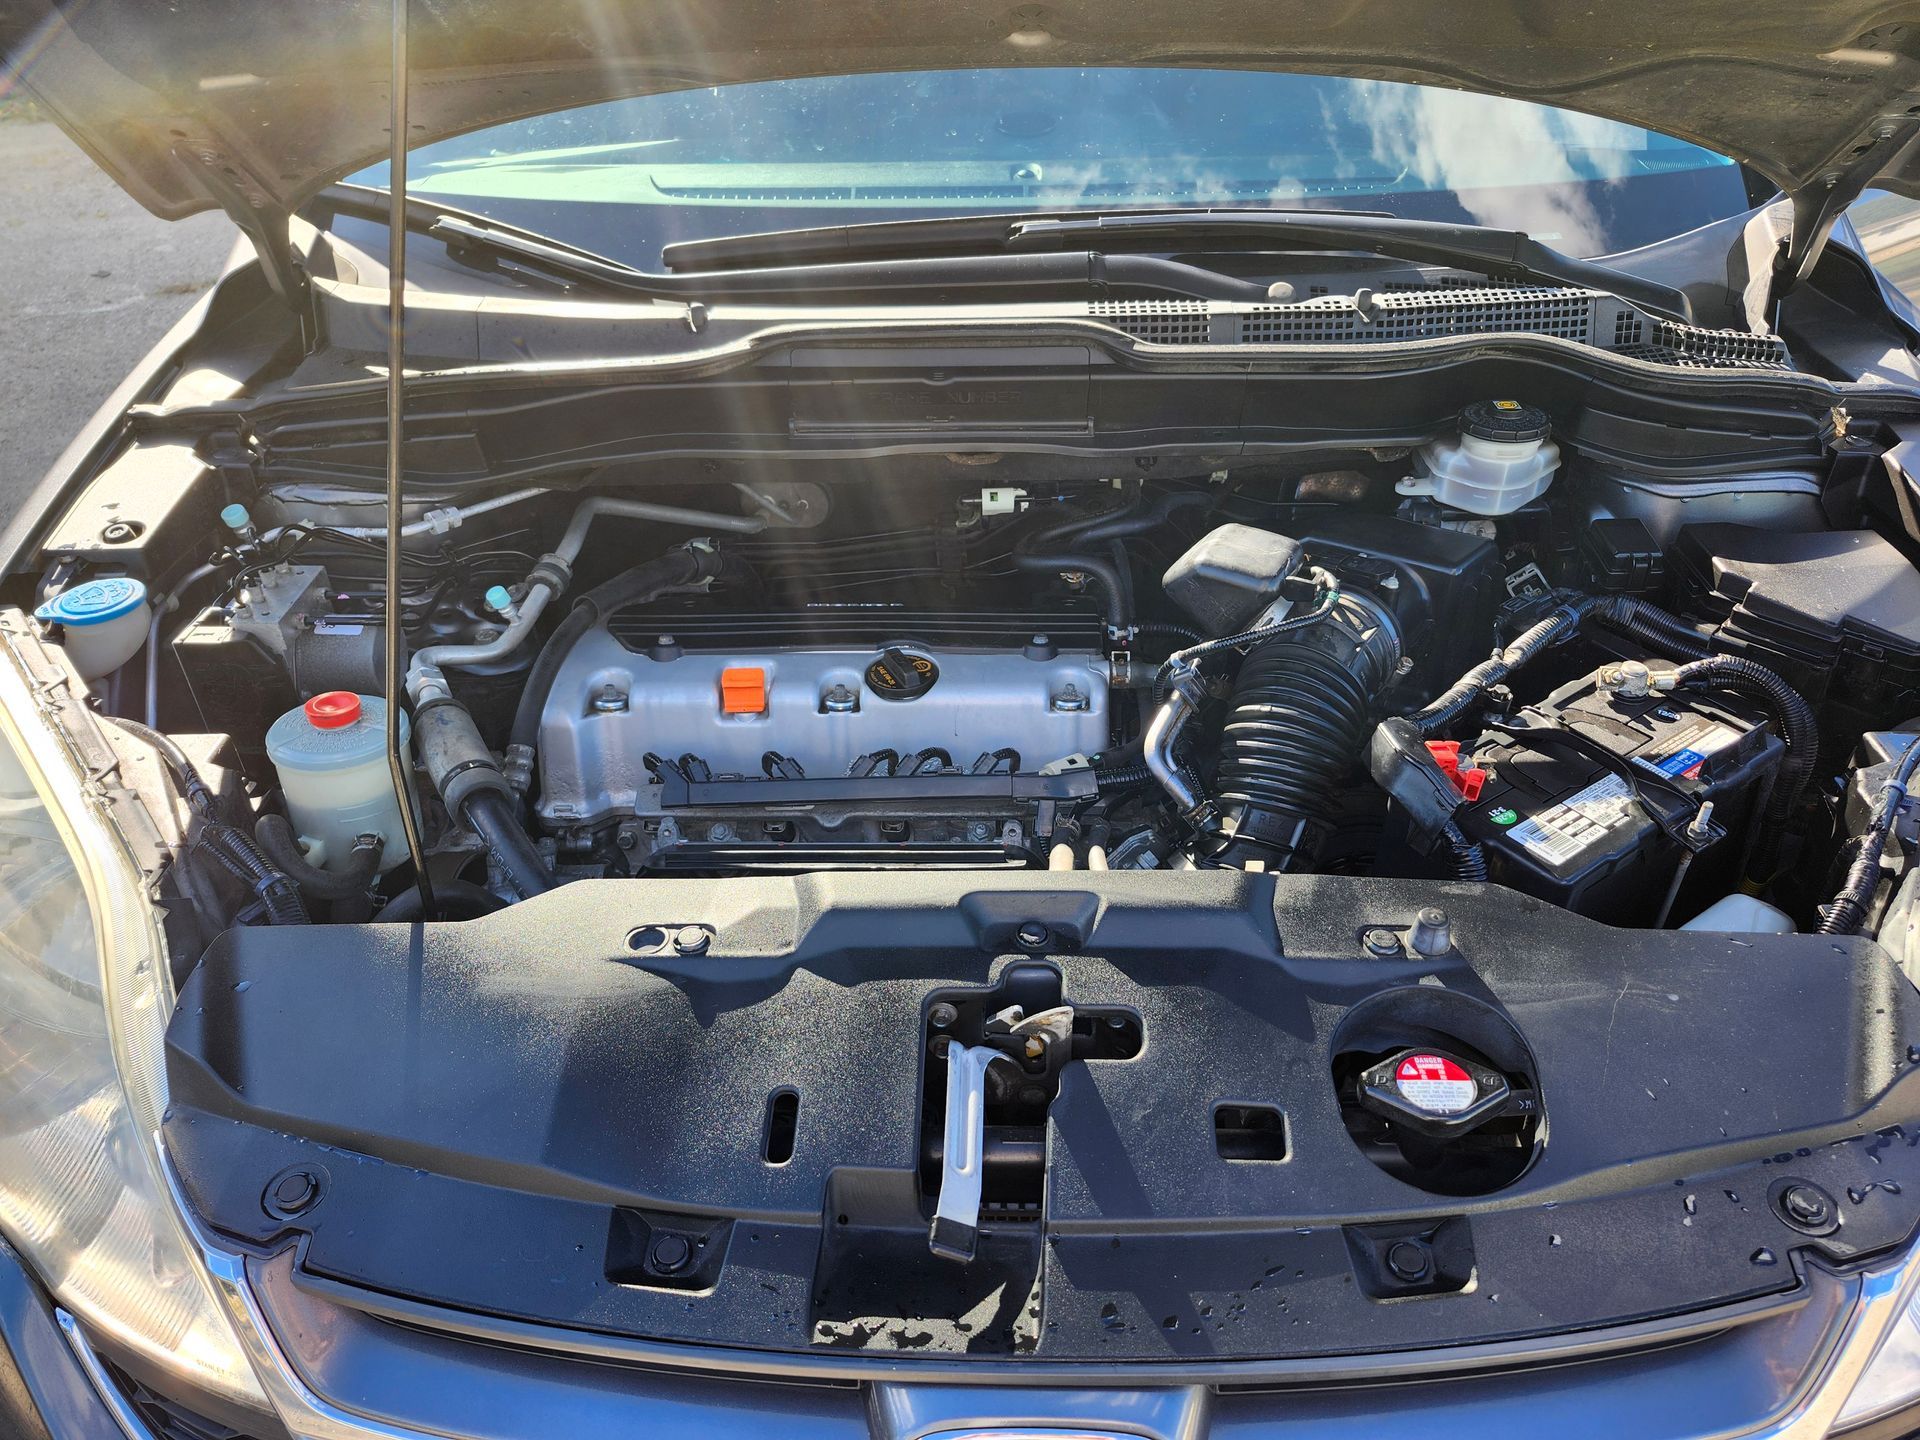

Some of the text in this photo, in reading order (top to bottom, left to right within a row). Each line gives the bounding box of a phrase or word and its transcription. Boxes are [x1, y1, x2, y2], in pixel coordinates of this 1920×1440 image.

[948, 391, 1022, 405] NUMBER
[1488, 806, 1507, 817] 3-21
[196, 1359, 225, 1375] STANLEY
